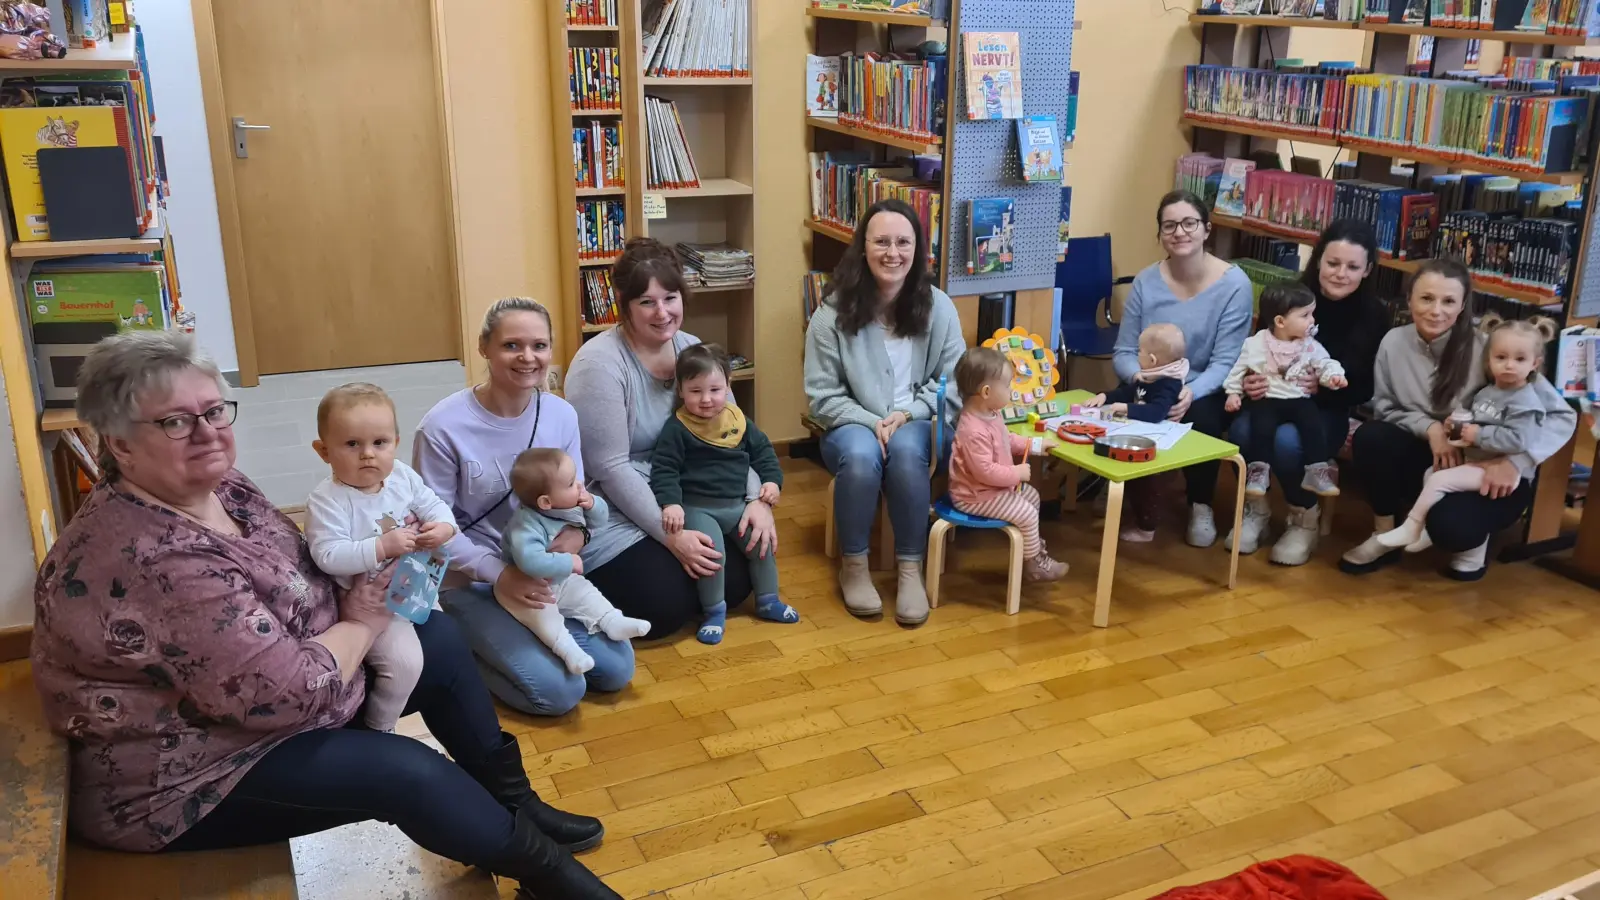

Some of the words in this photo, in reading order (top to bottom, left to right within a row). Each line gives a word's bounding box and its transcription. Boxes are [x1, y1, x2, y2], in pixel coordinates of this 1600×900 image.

[972, 52, 1014, 67] NERVT!
[60, 300, 114, 309] Bauernhof
[464, 453, 519, 496] PA
